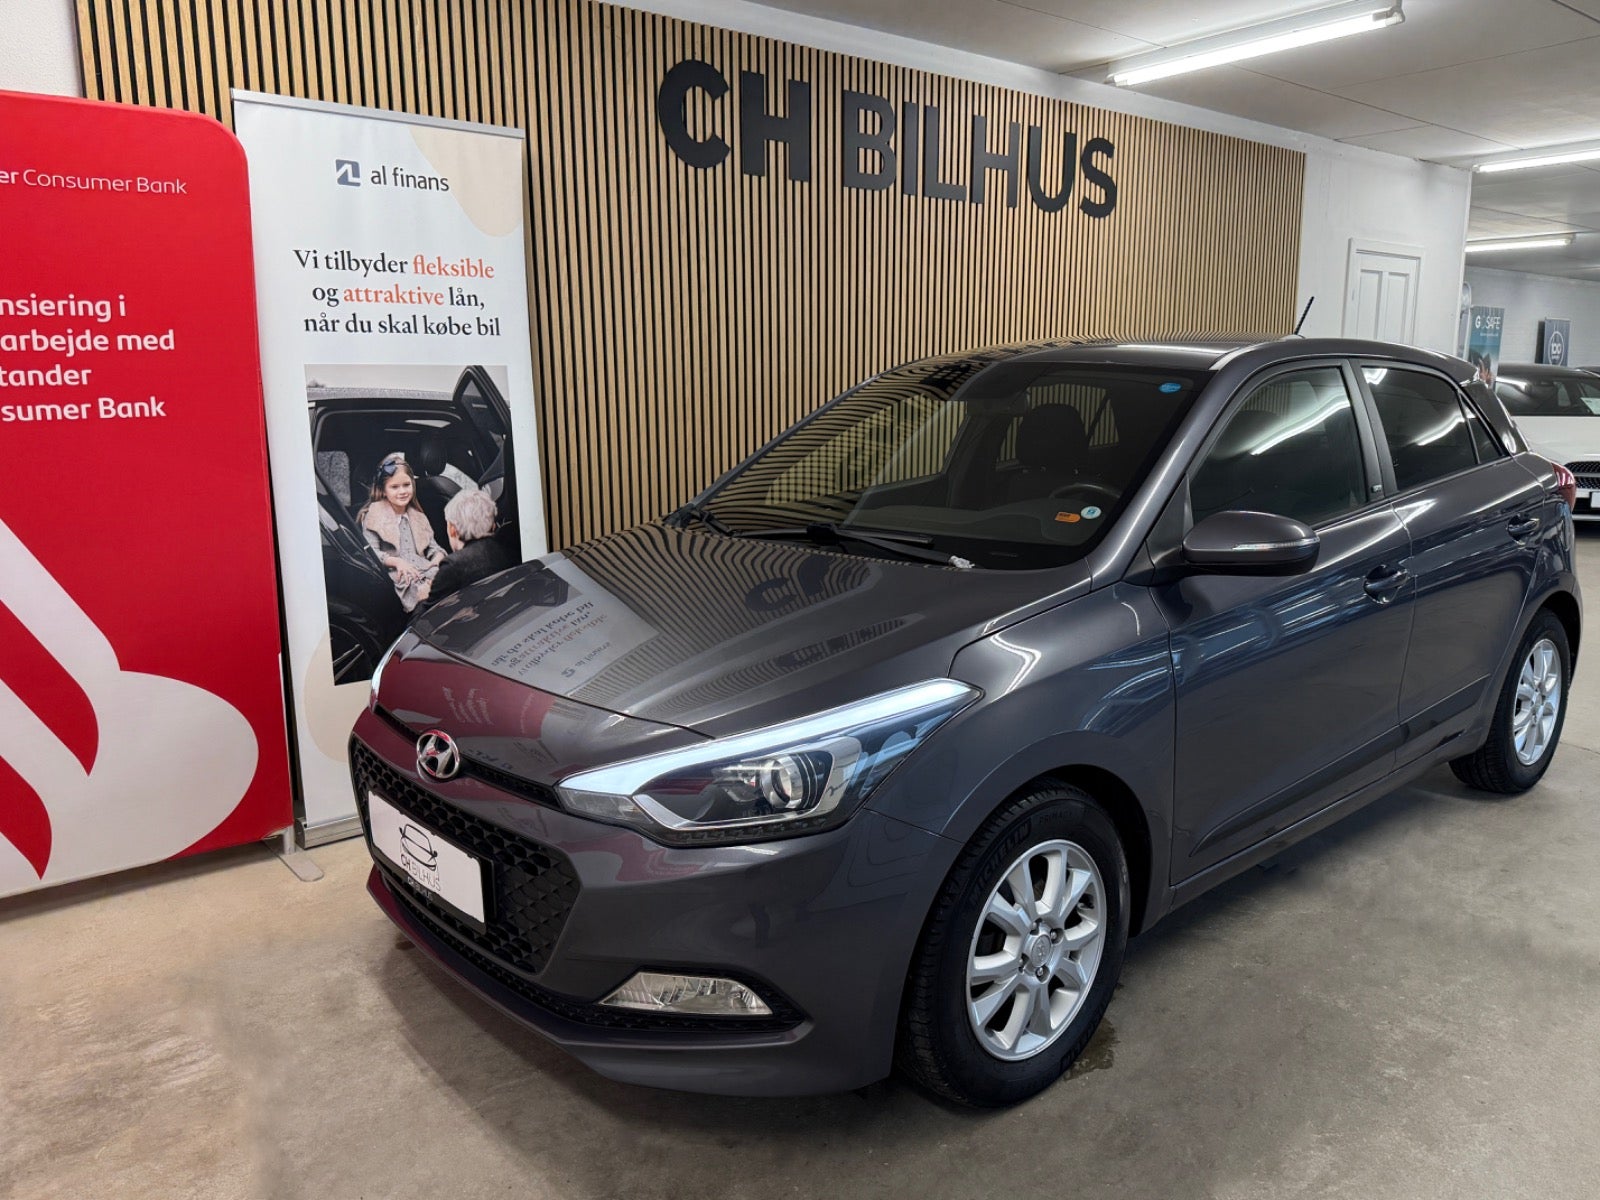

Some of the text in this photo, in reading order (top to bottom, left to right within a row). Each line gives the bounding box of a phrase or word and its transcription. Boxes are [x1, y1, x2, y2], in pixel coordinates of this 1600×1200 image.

[659, 59, 1118, 219] CH BILHUS
[0, 168, 187, 194] er Consumer Bank
[370, 165, 450, 191] al finans
[293, 249, 495, 278] Vi tilbyder fleksible
[0, 293, 127, 322] nsiering i
[312, 284, 485, 310] og attraktive lån,
[304, 311, 501, 337] når du skal købe bil
[0, 328, 175, 357] arbejde med
[0, 363, 92, 387] tander
[0, 396, 166, 421] sumer Bank
